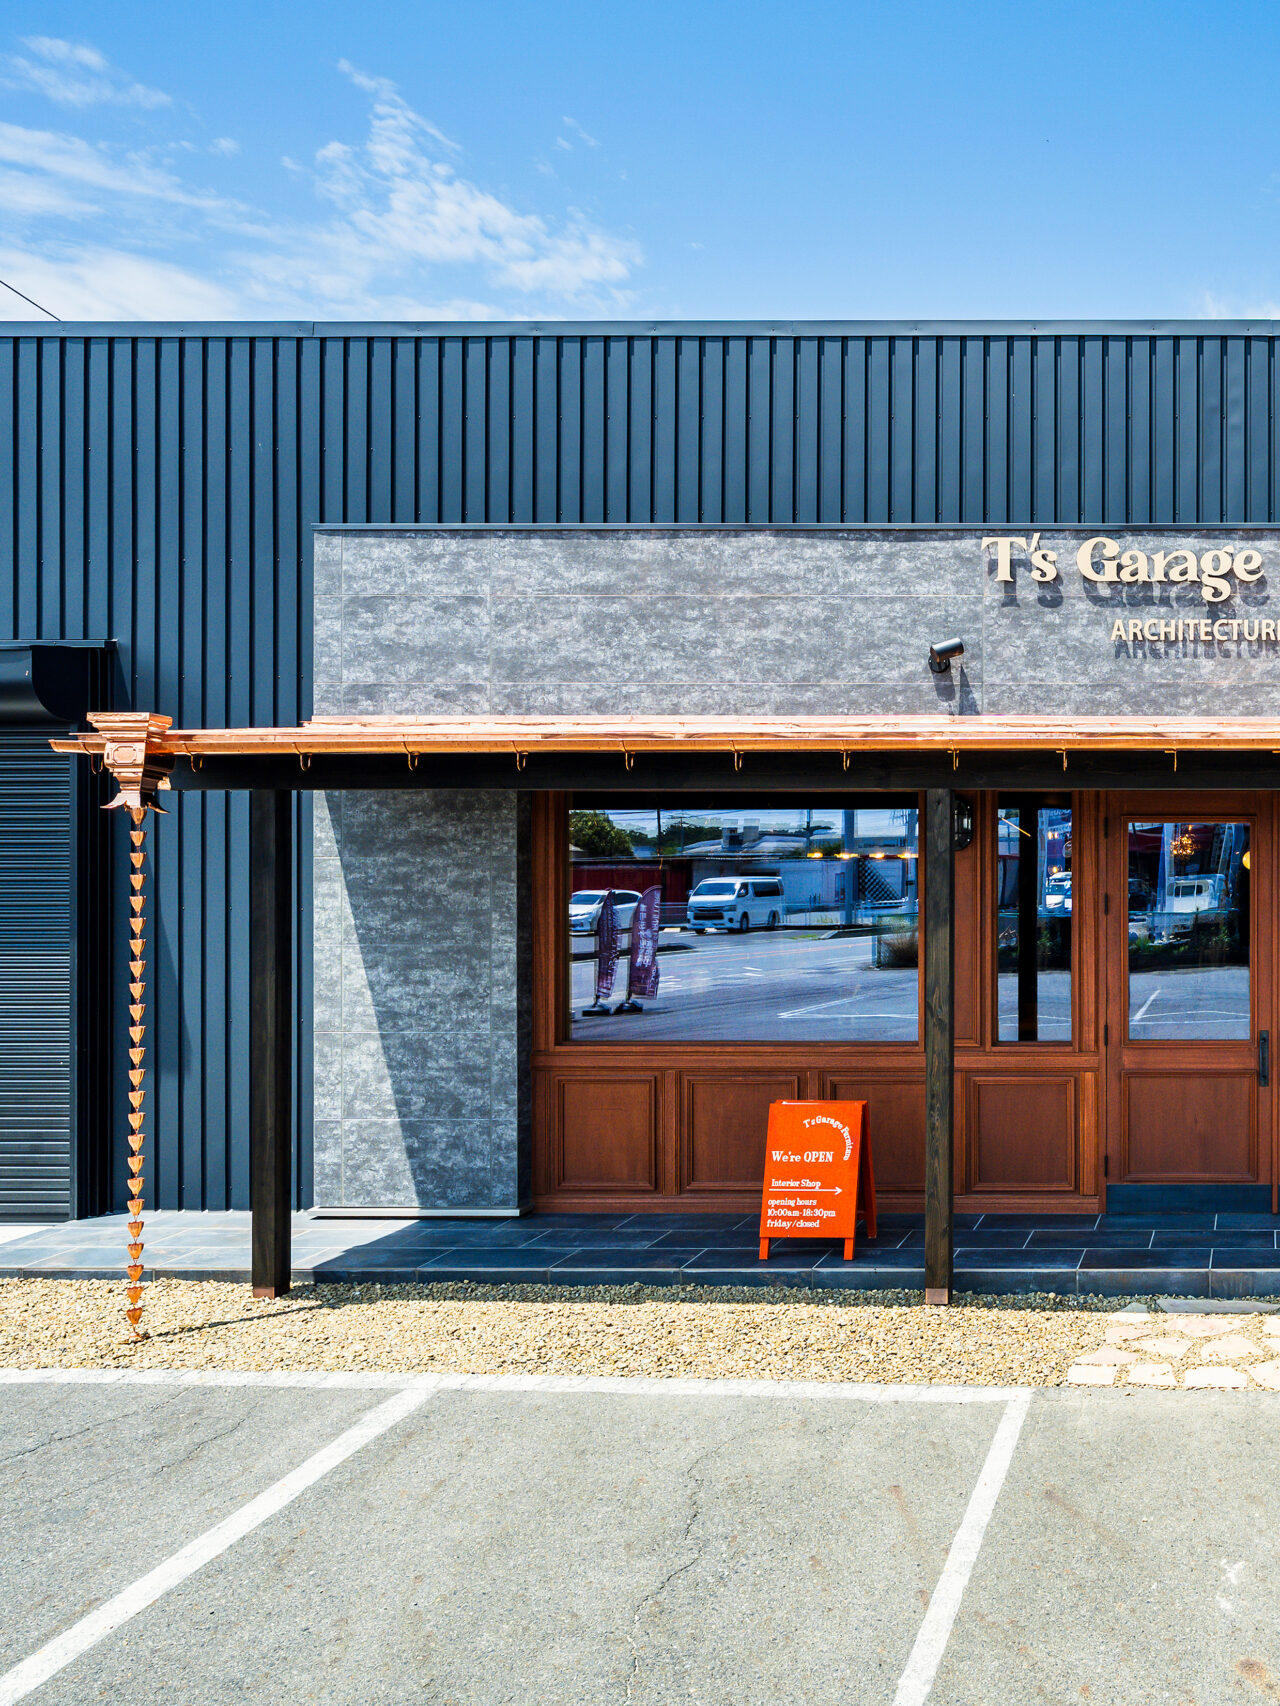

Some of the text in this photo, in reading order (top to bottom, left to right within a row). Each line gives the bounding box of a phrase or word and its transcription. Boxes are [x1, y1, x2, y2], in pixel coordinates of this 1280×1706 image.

[981, 533, 1057, 583] T's
[1076, 537, 1264, 602] Garage
[816, 1115, 842, 1129] Garage
[772, 1151, 834, 1163] We're OPEN
[772, 1179, 821, 1190] Interior Shop
[768, 1198, 817, 1207] opening hours
